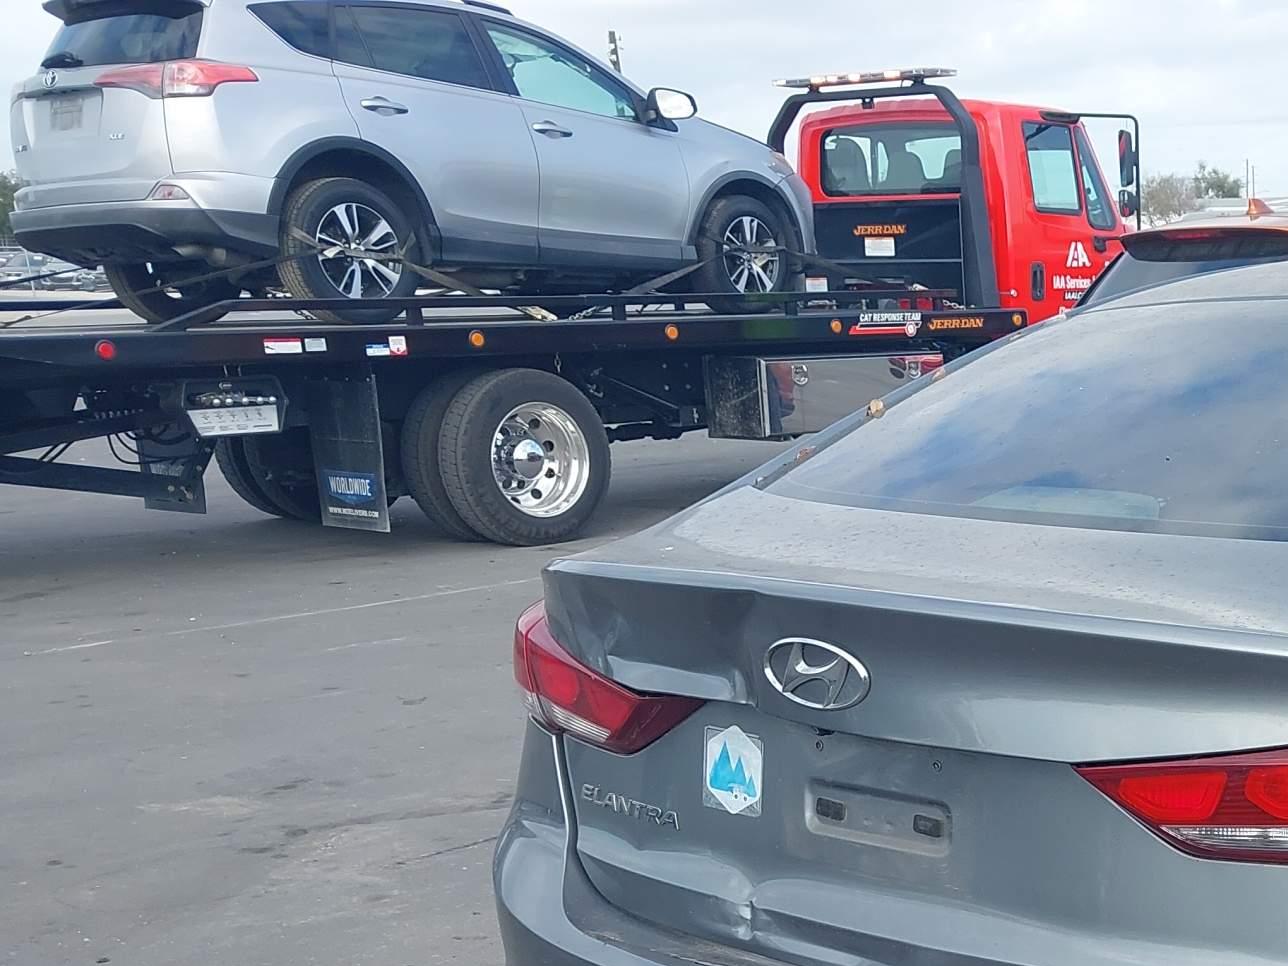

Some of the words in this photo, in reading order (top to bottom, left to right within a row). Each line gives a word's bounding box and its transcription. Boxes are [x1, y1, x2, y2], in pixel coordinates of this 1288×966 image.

[1053, 275, 1065, 289] IAA
[859, 313, 872, 322] CAT
[873, 313, 903, 322] RESPONSE
[904, 312, 922, 321] TEAM
[328, 476, 372, 497] WORLDWIDE
[582, 783, 680, 832] ELANTRA
